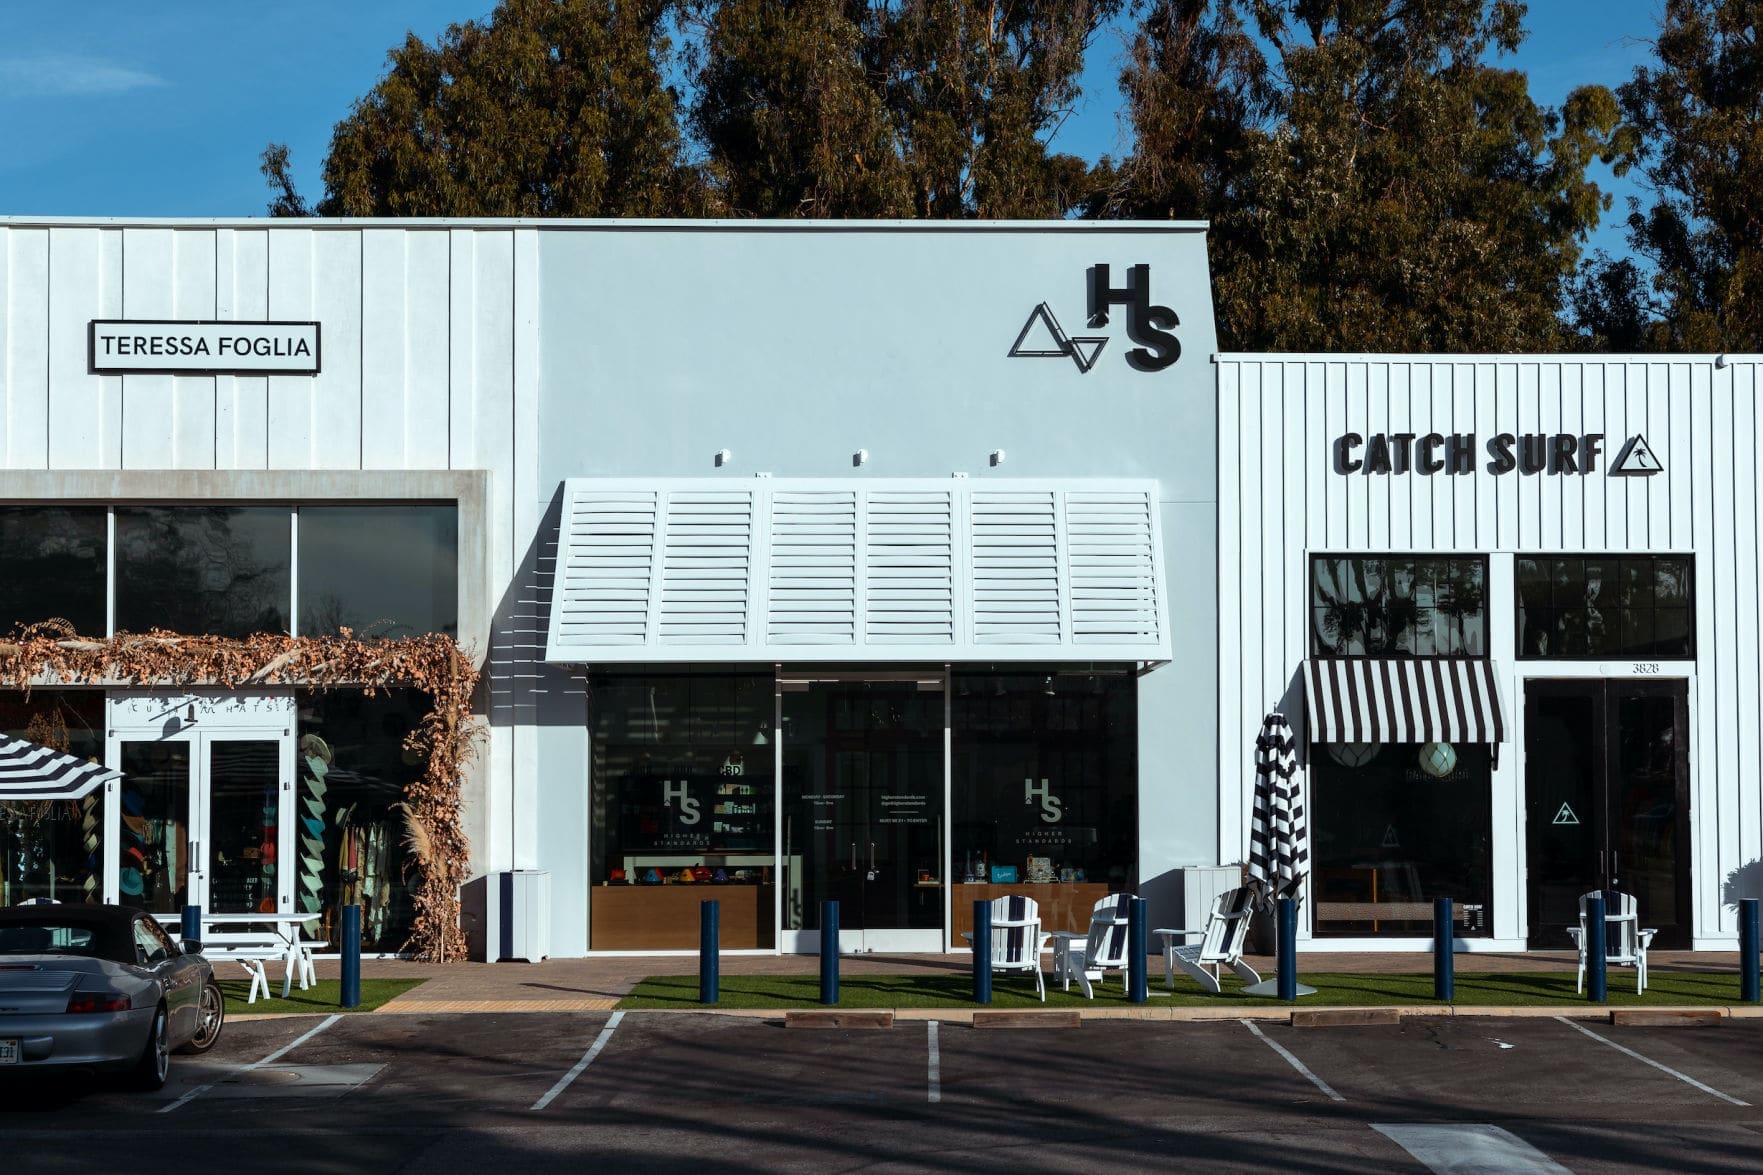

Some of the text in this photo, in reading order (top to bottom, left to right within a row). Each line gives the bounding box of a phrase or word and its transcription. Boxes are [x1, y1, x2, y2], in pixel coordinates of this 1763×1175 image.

[101, 336, 311, 357] TERESSA FOGLIA
[1334, 433, 1604, 475] CATCH SURF
